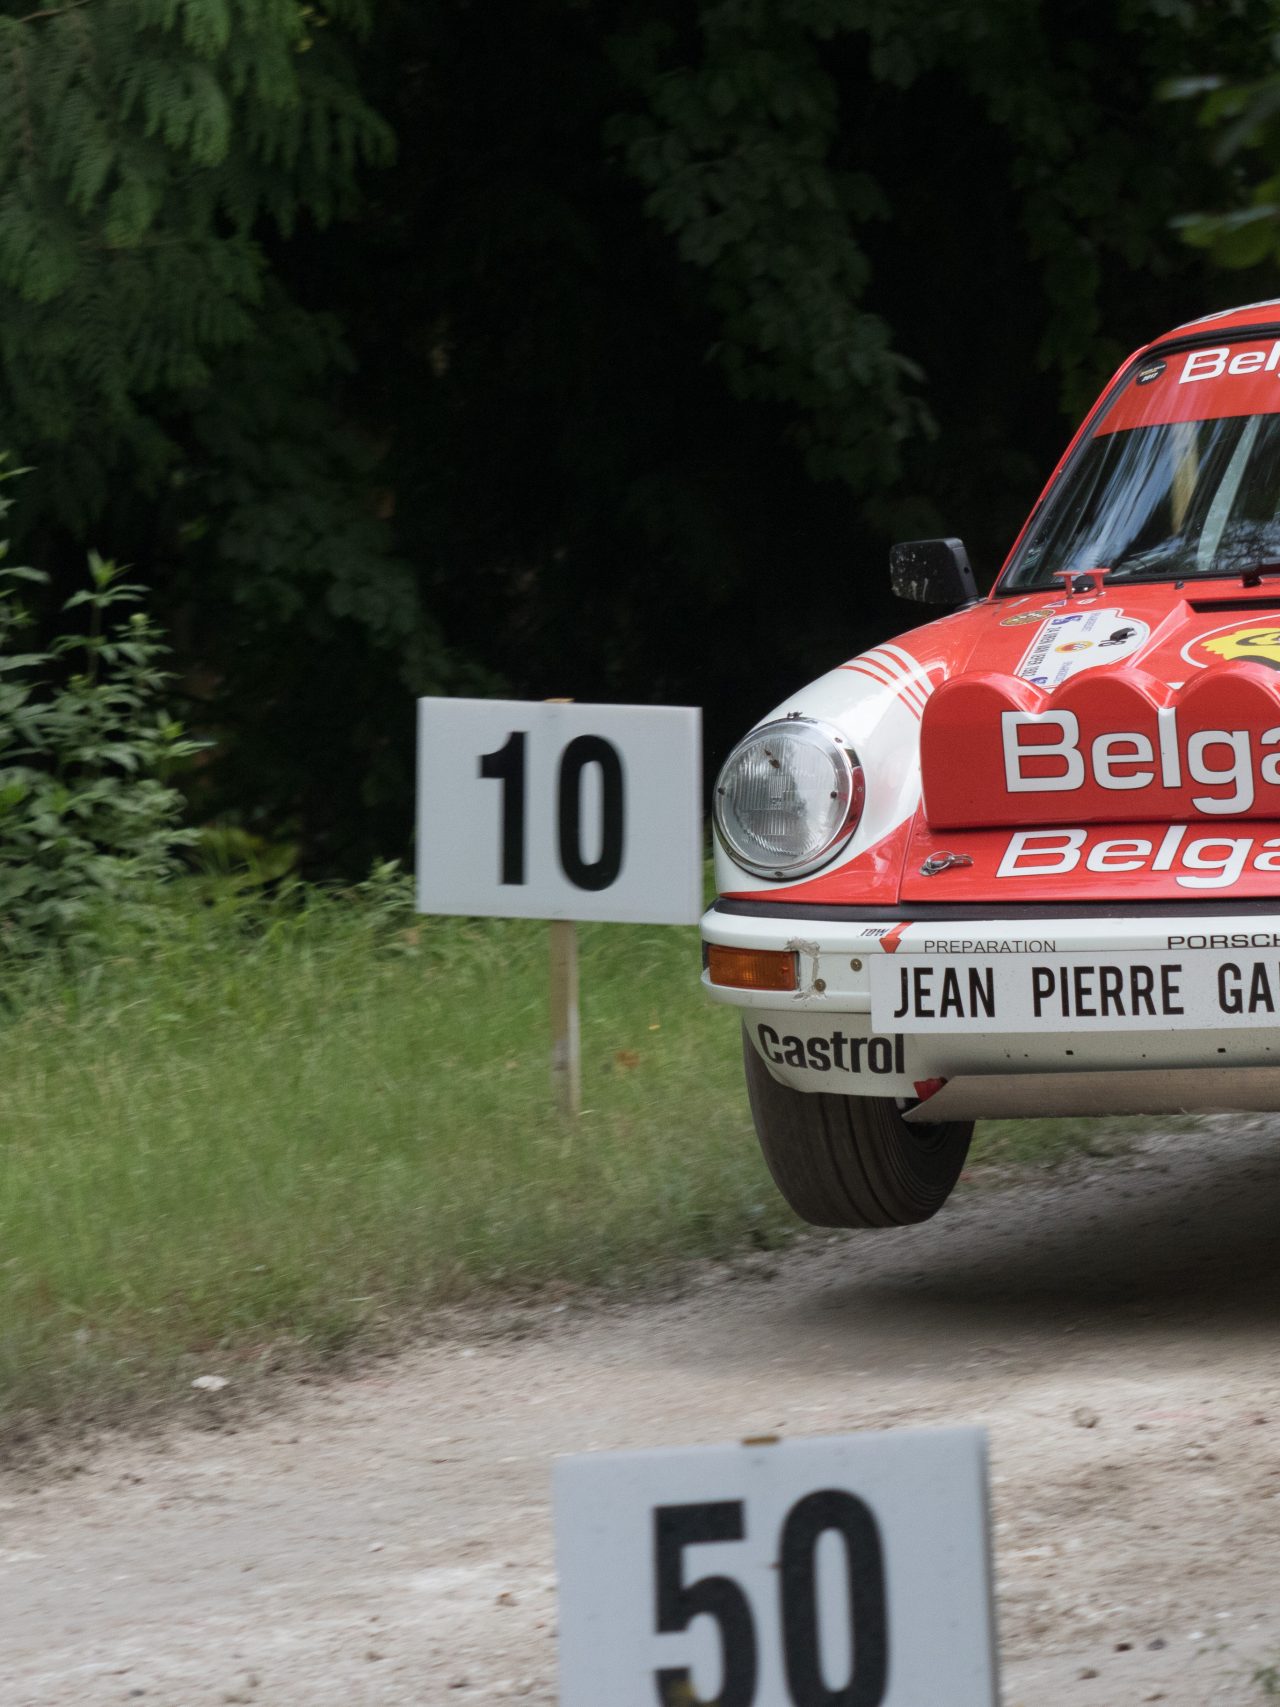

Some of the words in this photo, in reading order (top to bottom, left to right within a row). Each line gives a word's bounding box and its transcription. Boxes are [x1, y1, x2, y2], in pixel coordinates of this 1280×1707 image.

[476, 730, 627, 892] 10
[924, 940, 1056, 953] PREPARATION
[893, 967, 996, 1018] JEAN
[1032, 964, 1185, 1017] PIERRE
[757, 1023, 905, 1074] Castrol
[653, 1487, 890, 1707] 50
